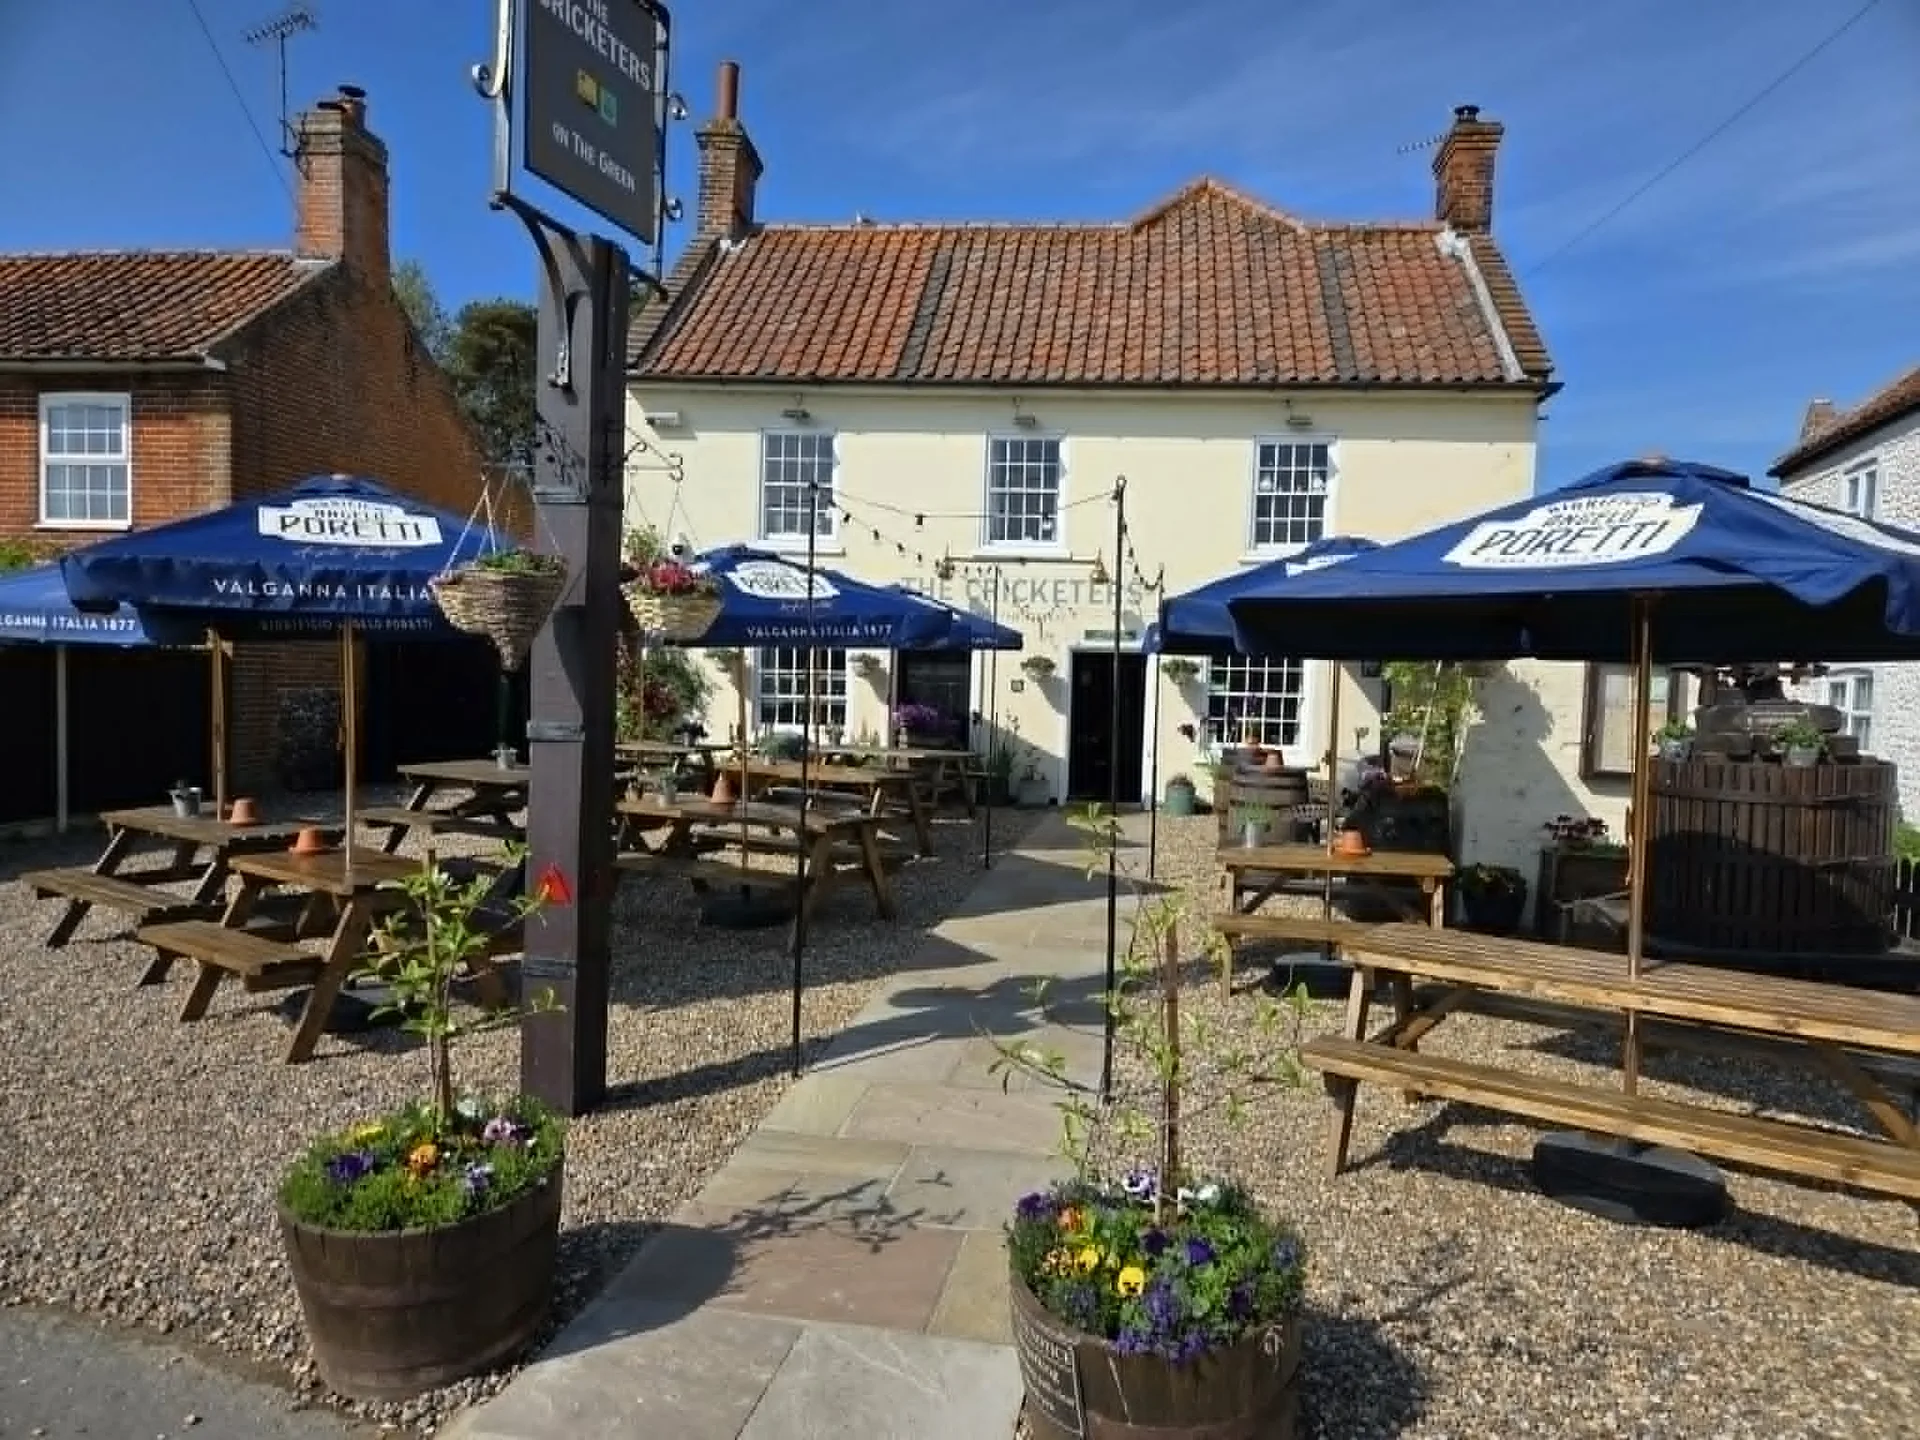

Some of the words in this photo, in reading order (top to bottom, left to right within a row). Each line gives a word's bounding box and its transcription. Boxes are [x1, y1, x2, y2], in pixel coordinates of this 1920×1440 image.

[540, 0, 651, 91] RICKETERS
[279, 515, 423, 541] PORETTI
[1471, 520, 1669, 556] PORETTI
[213, 578, 346, 600] VALGANNA
[356, 584, 431, 601] ITALIA
[53, 614, 98, 631] ITALIA
[103, 617, 136, 631] 1877
